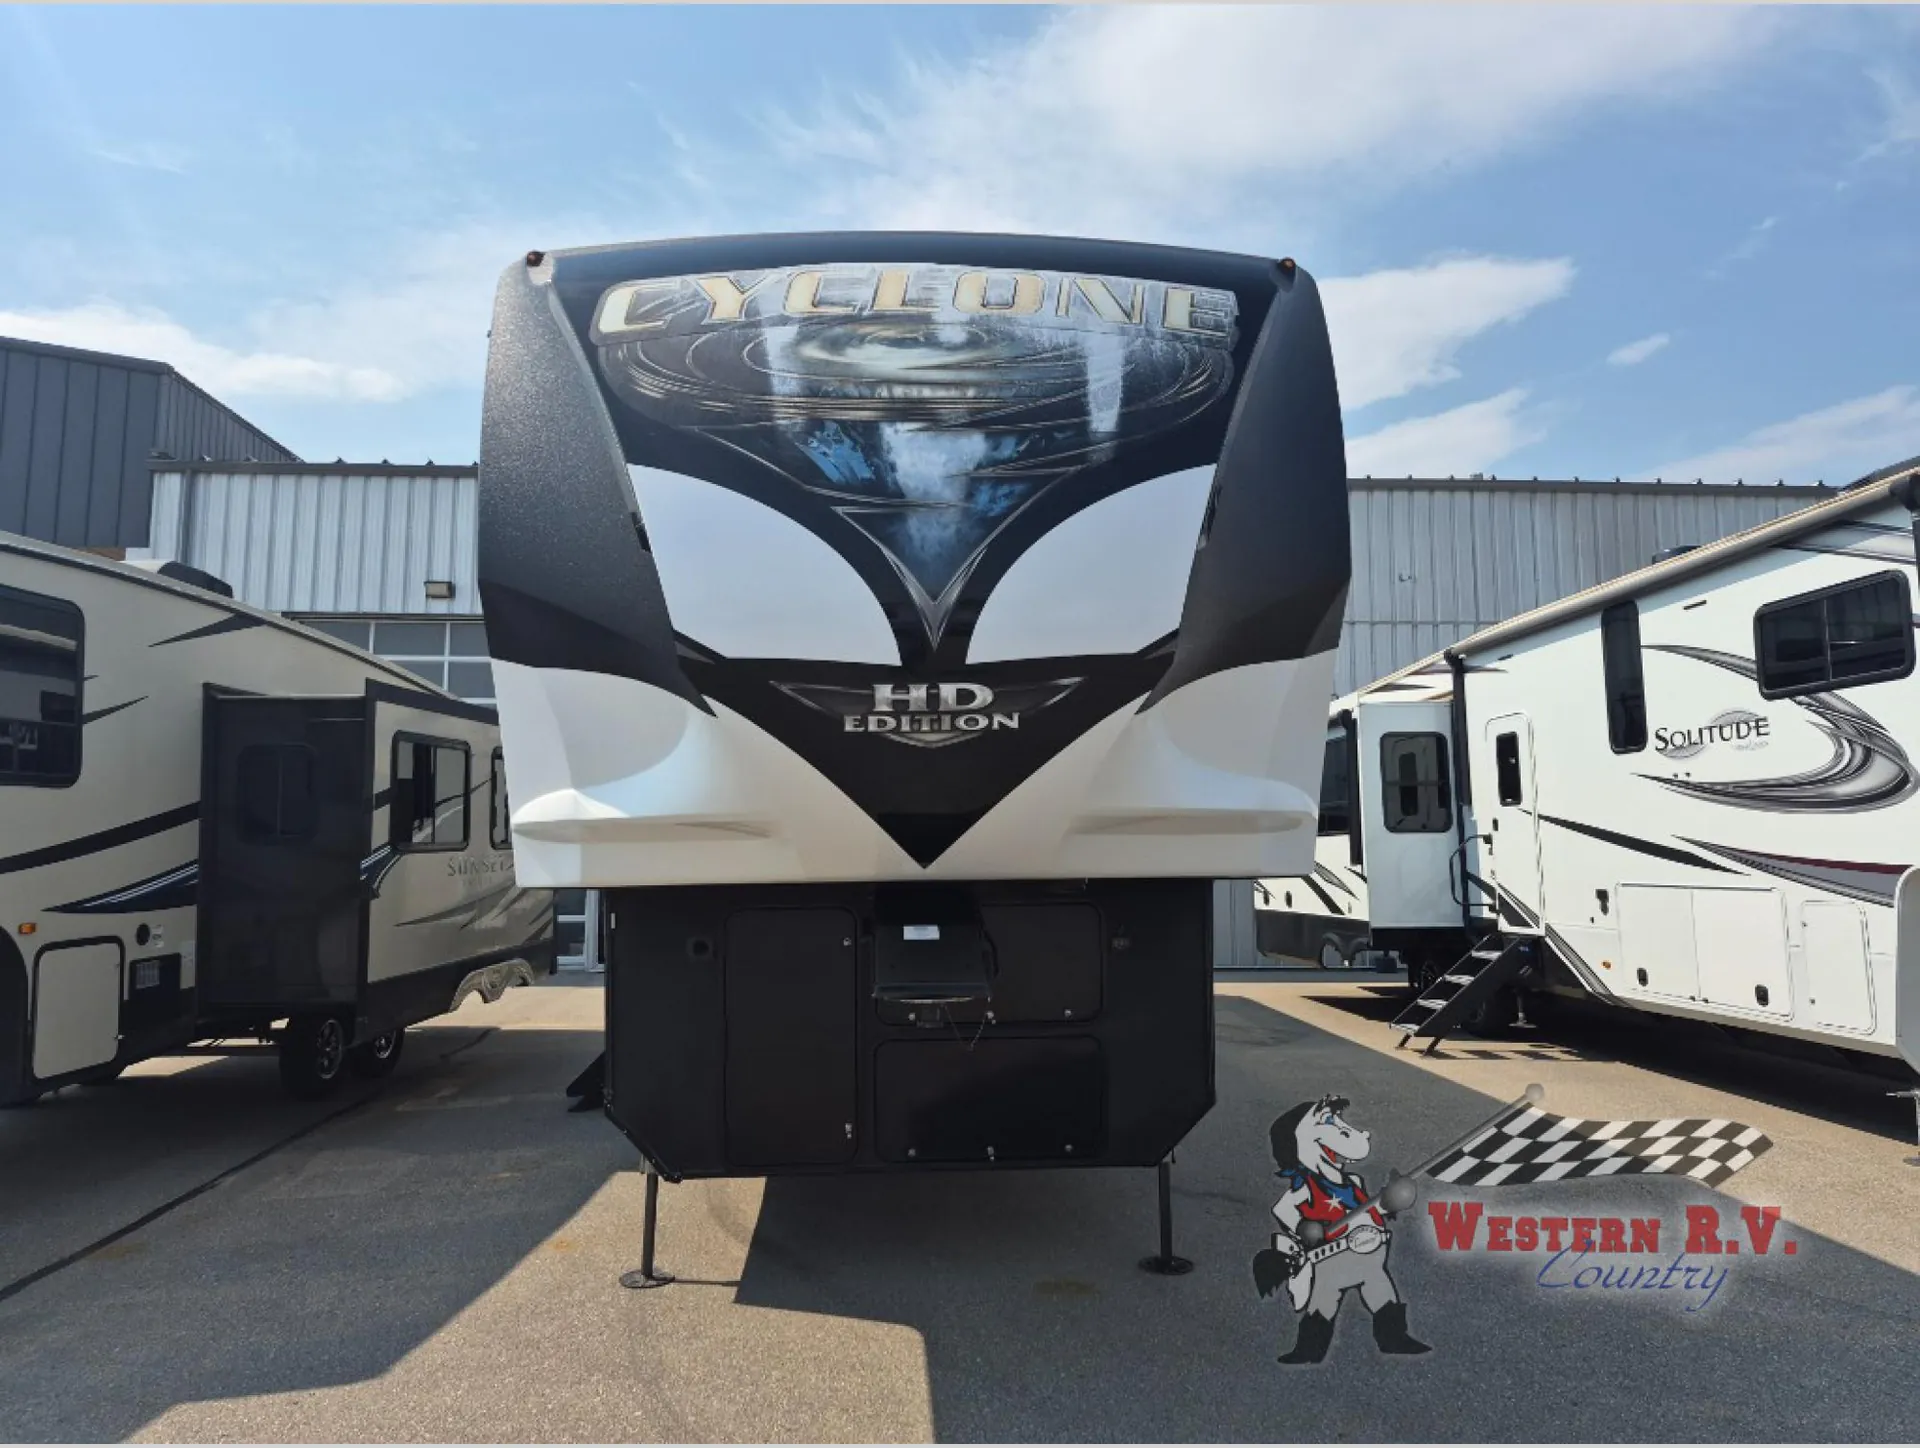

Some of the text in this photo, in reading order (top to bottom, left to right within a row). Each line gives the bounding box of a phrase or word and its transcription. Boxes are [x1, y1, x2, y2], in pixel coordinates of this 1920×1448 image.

[597, 269, 1238, 338] CYCLONE
[872, 682, 995, 712] HD
[843, 711, 1020, 733] EDITION
[1655, 716, 1771, 751] SOLITUDE
